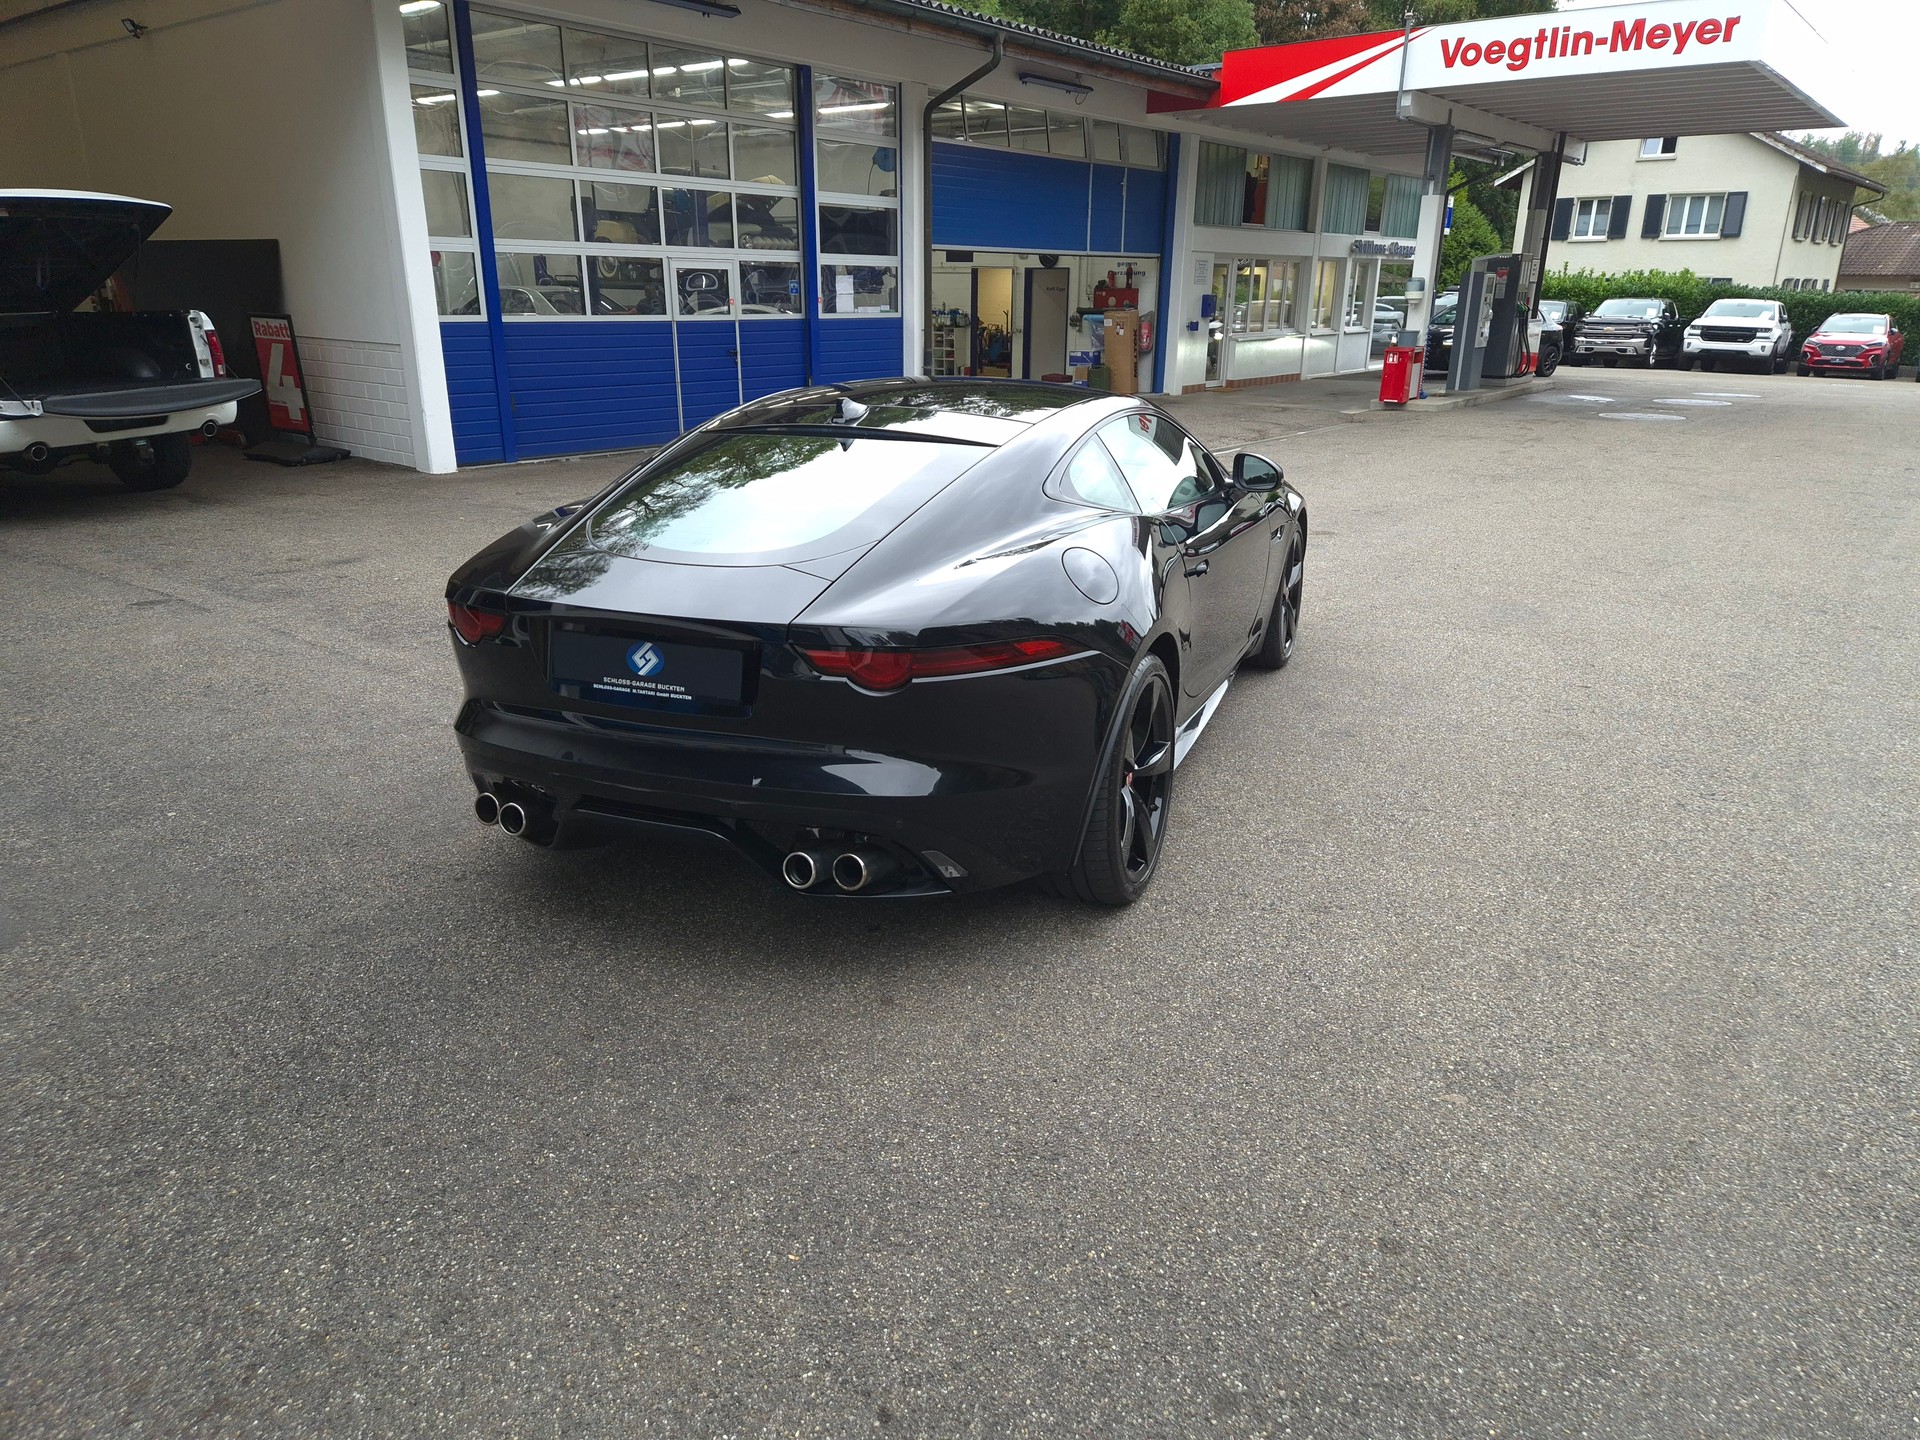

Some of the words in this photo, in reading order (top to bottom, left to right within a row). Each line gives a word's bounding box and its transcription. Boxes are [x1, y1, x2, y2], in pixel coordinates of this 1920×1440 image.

[1440, 15, 1741, 71] Voegtlin-Meyer
[1353, 240, 1387, 254] Schloss
[253, 320, 290, 338] Rabatt
[267, 343, 305, 421] 4
[593, 684, 631, 692] SCHLOSS-GARAGE
[603, 677, 656, 688] SCHLOSS-GARAGE
[657, 683, 685, 692] BUCKTEN
